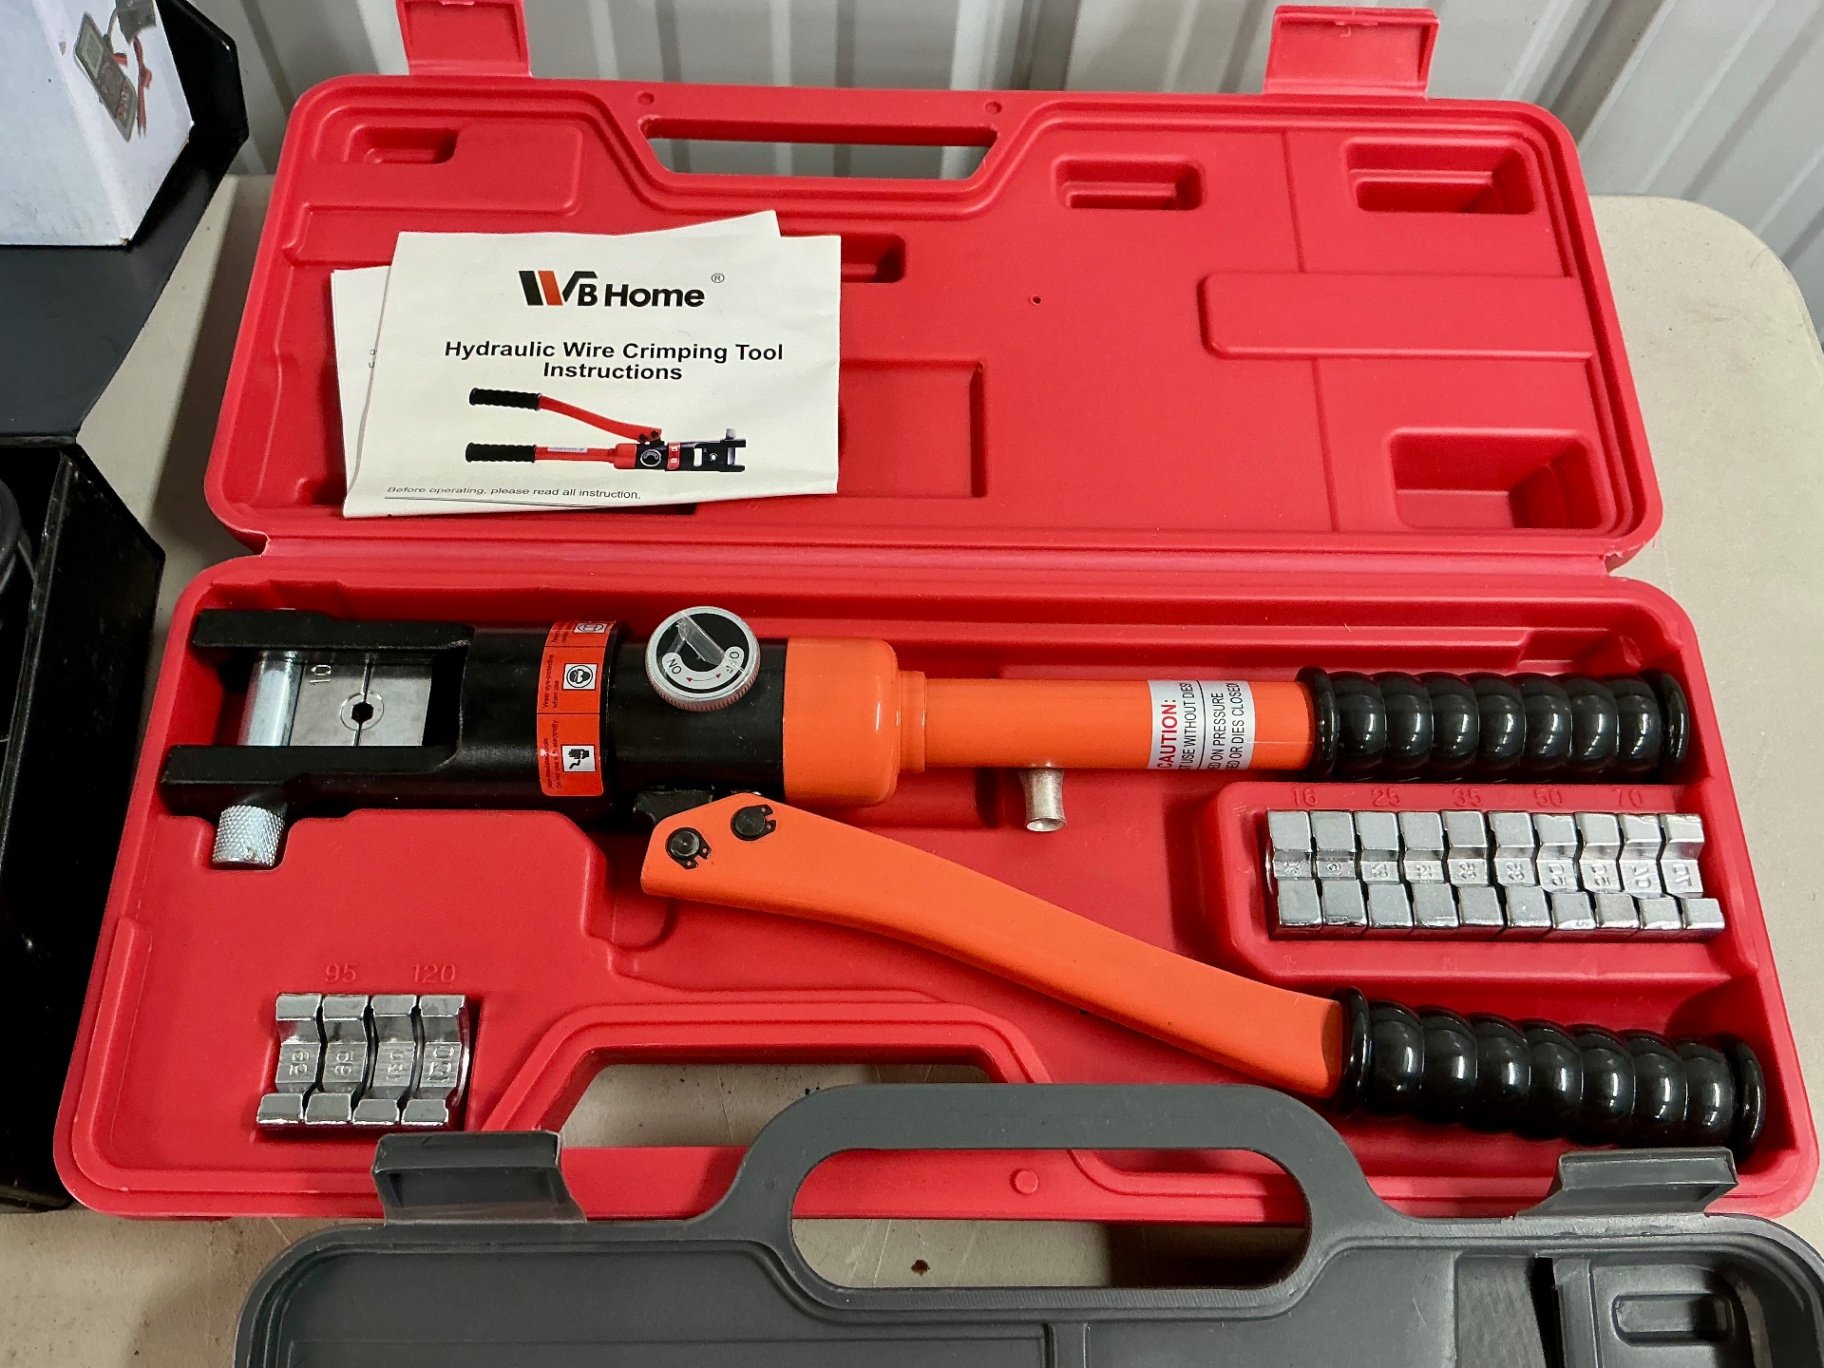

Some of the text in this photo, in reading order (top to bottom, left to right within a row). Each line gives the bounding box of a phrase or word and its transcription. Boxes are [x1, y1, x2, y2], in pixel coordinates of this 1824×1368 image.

[604, 284, 705, 307] Home
[445, 341, 783, 363] Hydraulic Wire Crimping Tool
[543, 362, 683, 380] Instructions
[490, 487, 529, 495] please
[533, 488, 559, 496] read
[562, 487, 576, 496] all
[579, 489, 641, 499] instruction.
[667, 658, 682, 674] ON
[1183, 700, 1197, 747] WITHOUT
[1211, 692, 1226, 747] PRESSURE
[1157, 699, 1178, 769] CAUTION:
[1231, 719, 1244, 744] DIES
[1181, 749, 1195, 764] USE
[1210, 748, 1223, 762] ON
[1229, 746, 1243, 760] OR
[1293, 788, 1643, 808] 16 25 35 50 70
[324, 963, 457, 984] 95 120
